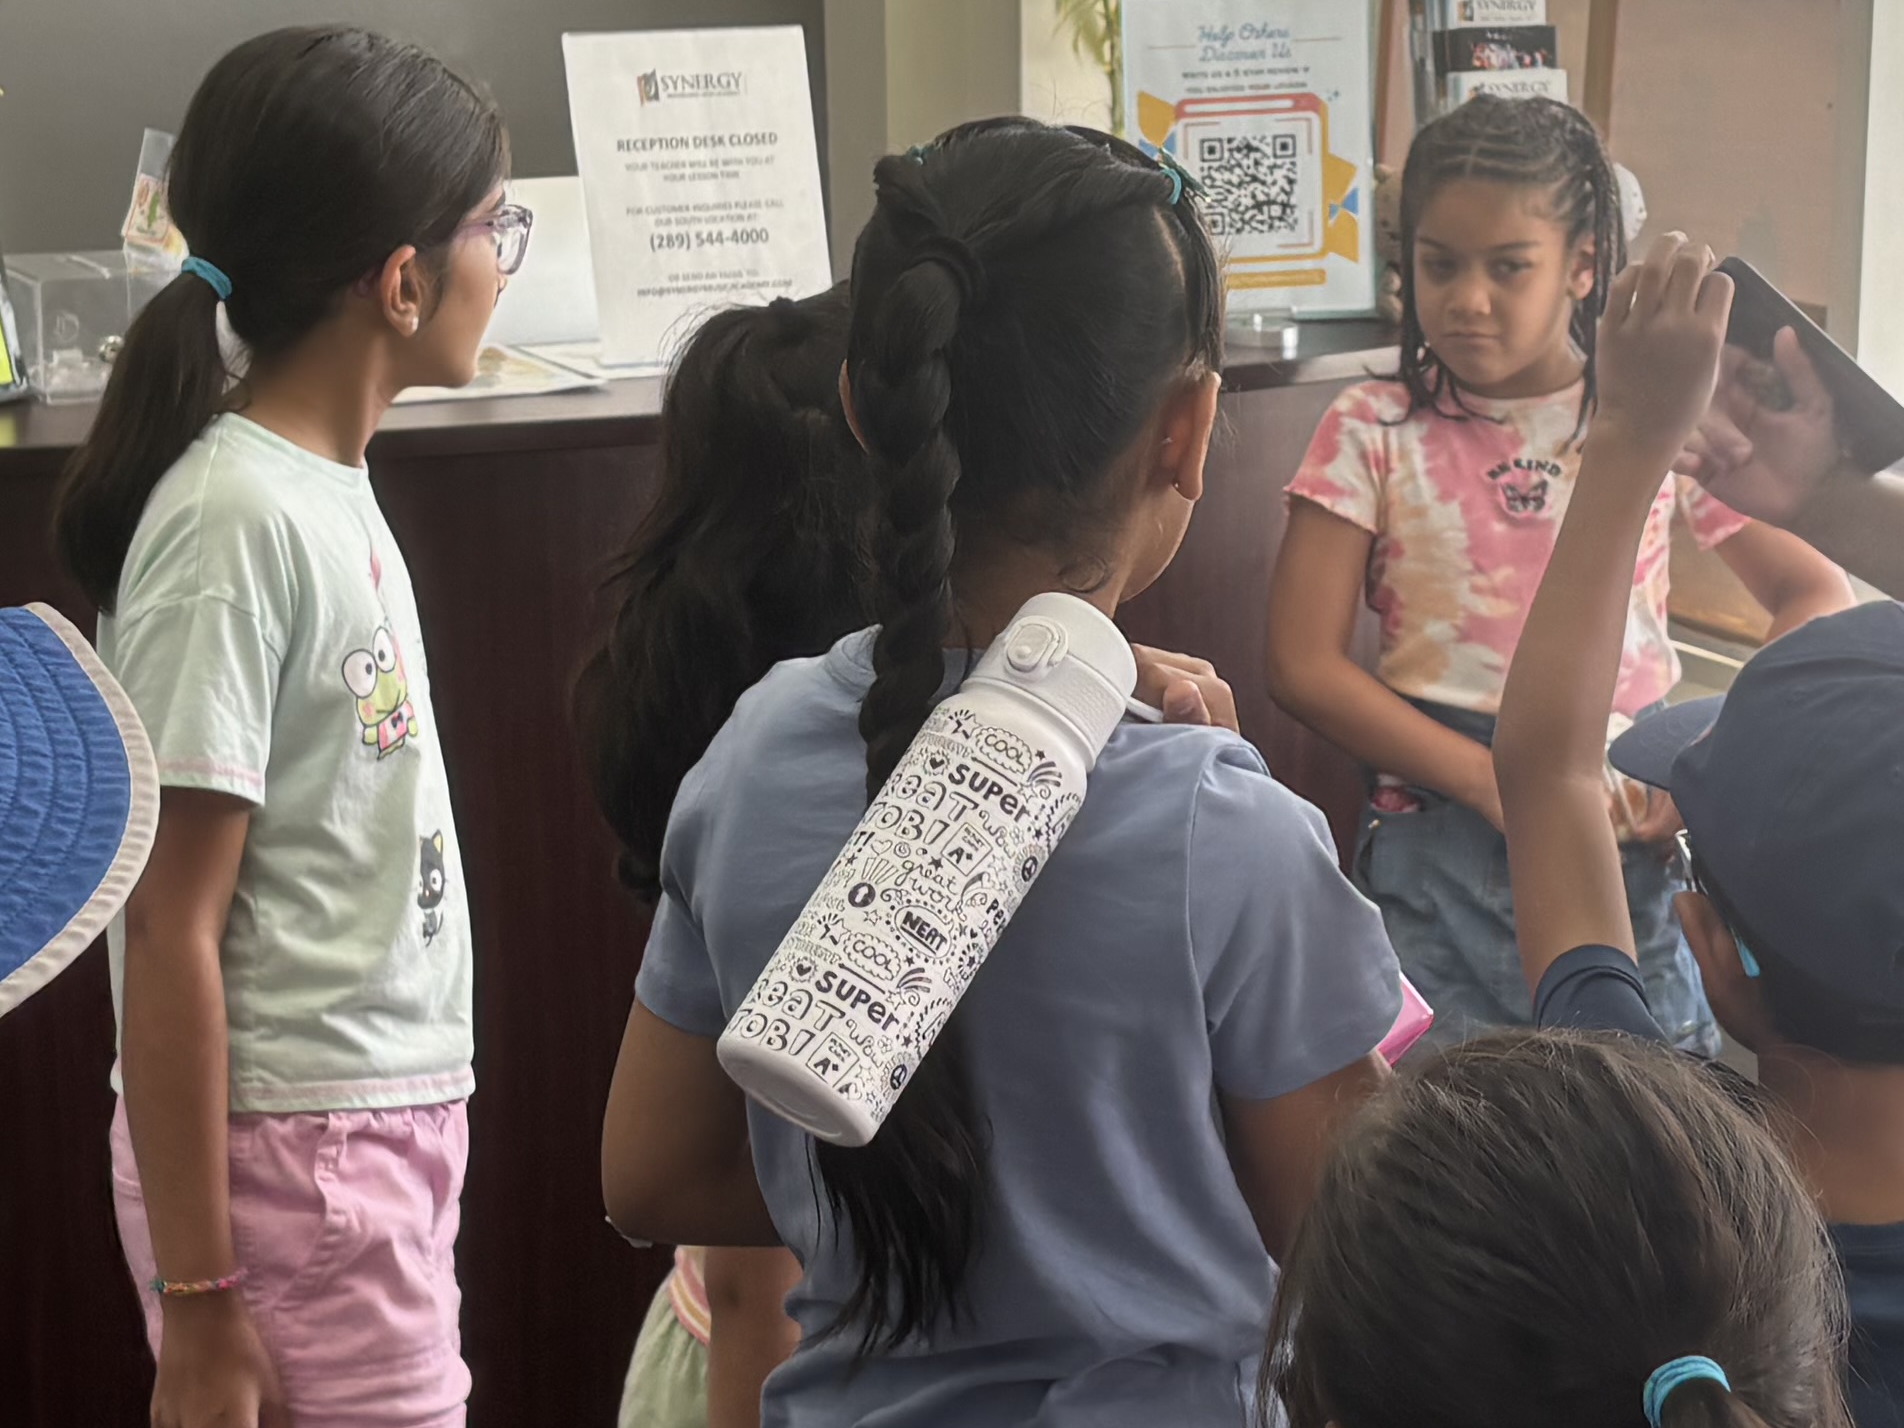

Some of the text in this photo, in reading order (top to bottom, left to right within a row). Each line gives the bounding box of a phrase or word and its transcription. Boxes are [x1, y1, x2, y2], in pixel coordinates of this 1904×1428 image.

[660, 71, 742, 92] SYNERGY
[616, 132, 778, 152] RECEPTION DESK CLOSED
[650, 227, 769, 252] (289) 544-4000
[985, 733, 1025, 770] COOL
[901, 910, 948, 952] NEAT
[852, 939, 895, 977] COOL
